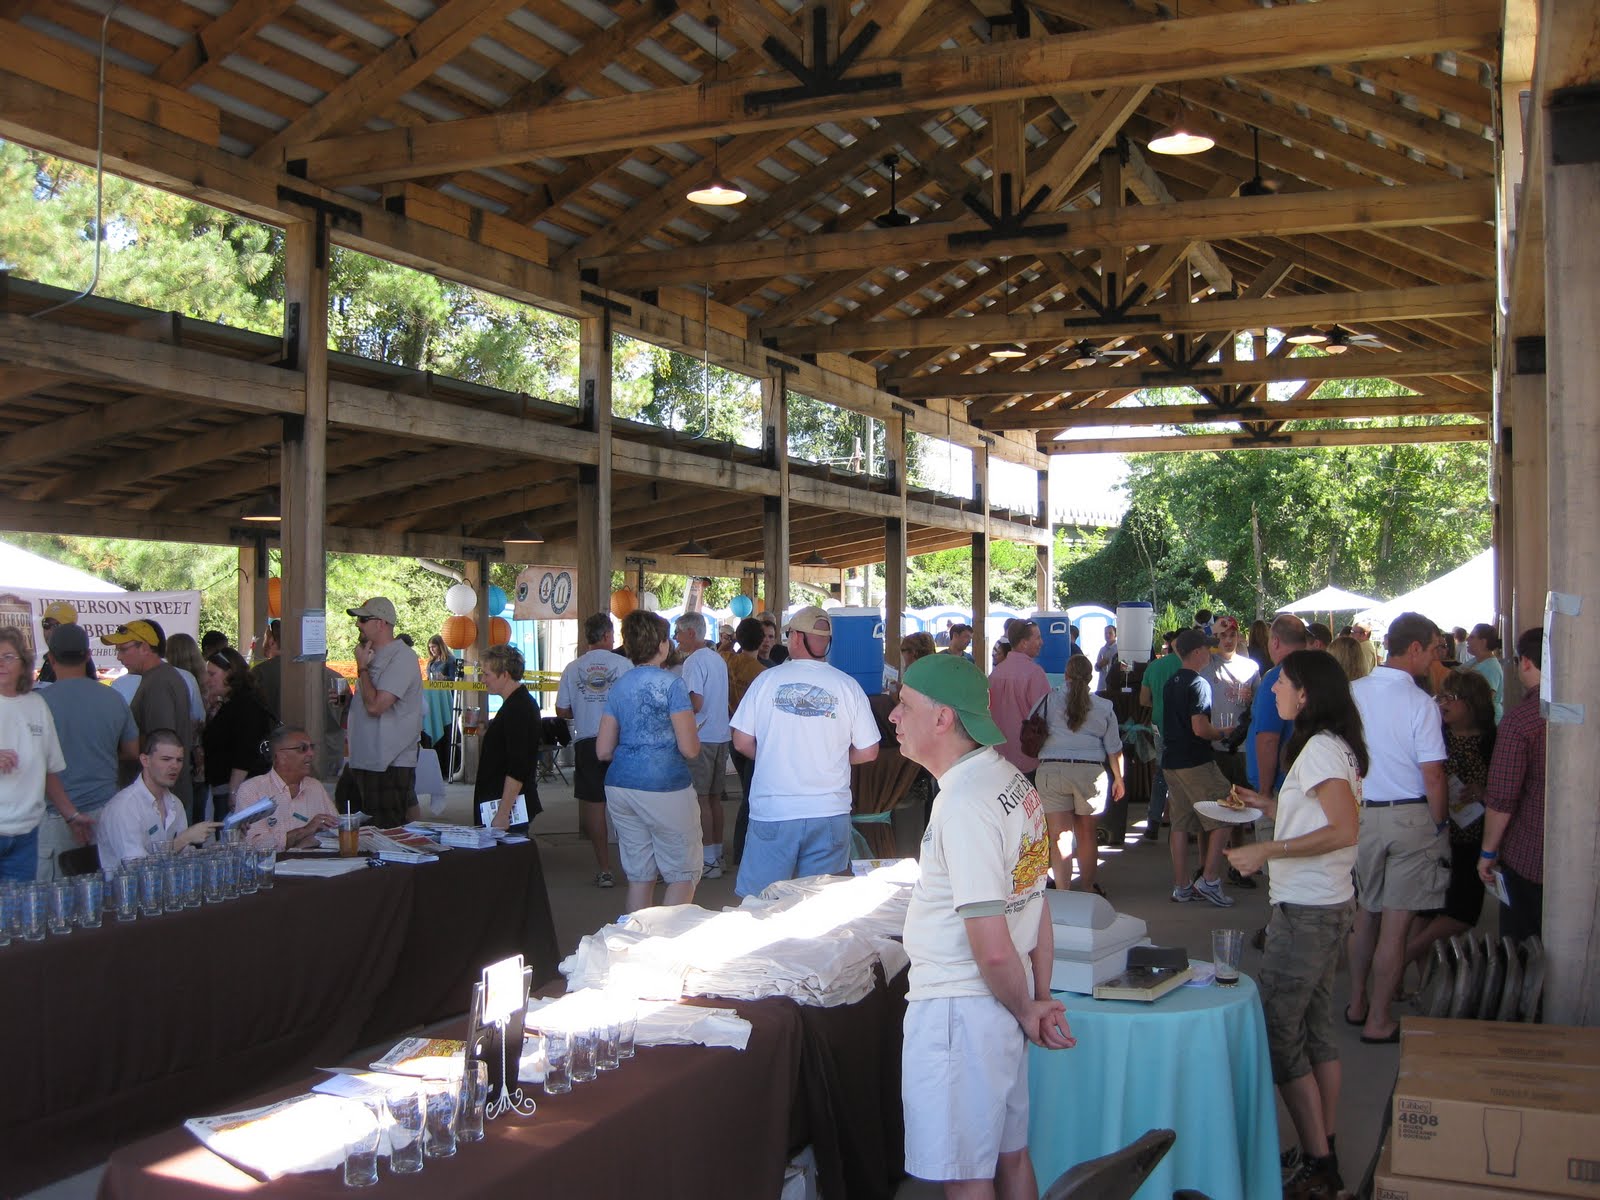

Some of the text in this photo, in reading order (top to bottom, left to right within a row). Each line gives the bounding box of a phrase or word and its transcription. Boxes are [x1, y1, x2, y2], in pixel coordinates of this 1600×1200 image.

[38, 598, 191, 617] JERSON STREET
[1401, 1100, 1429, 1113] Libbey
[1399, 1112, 1439, 1127] 4808
